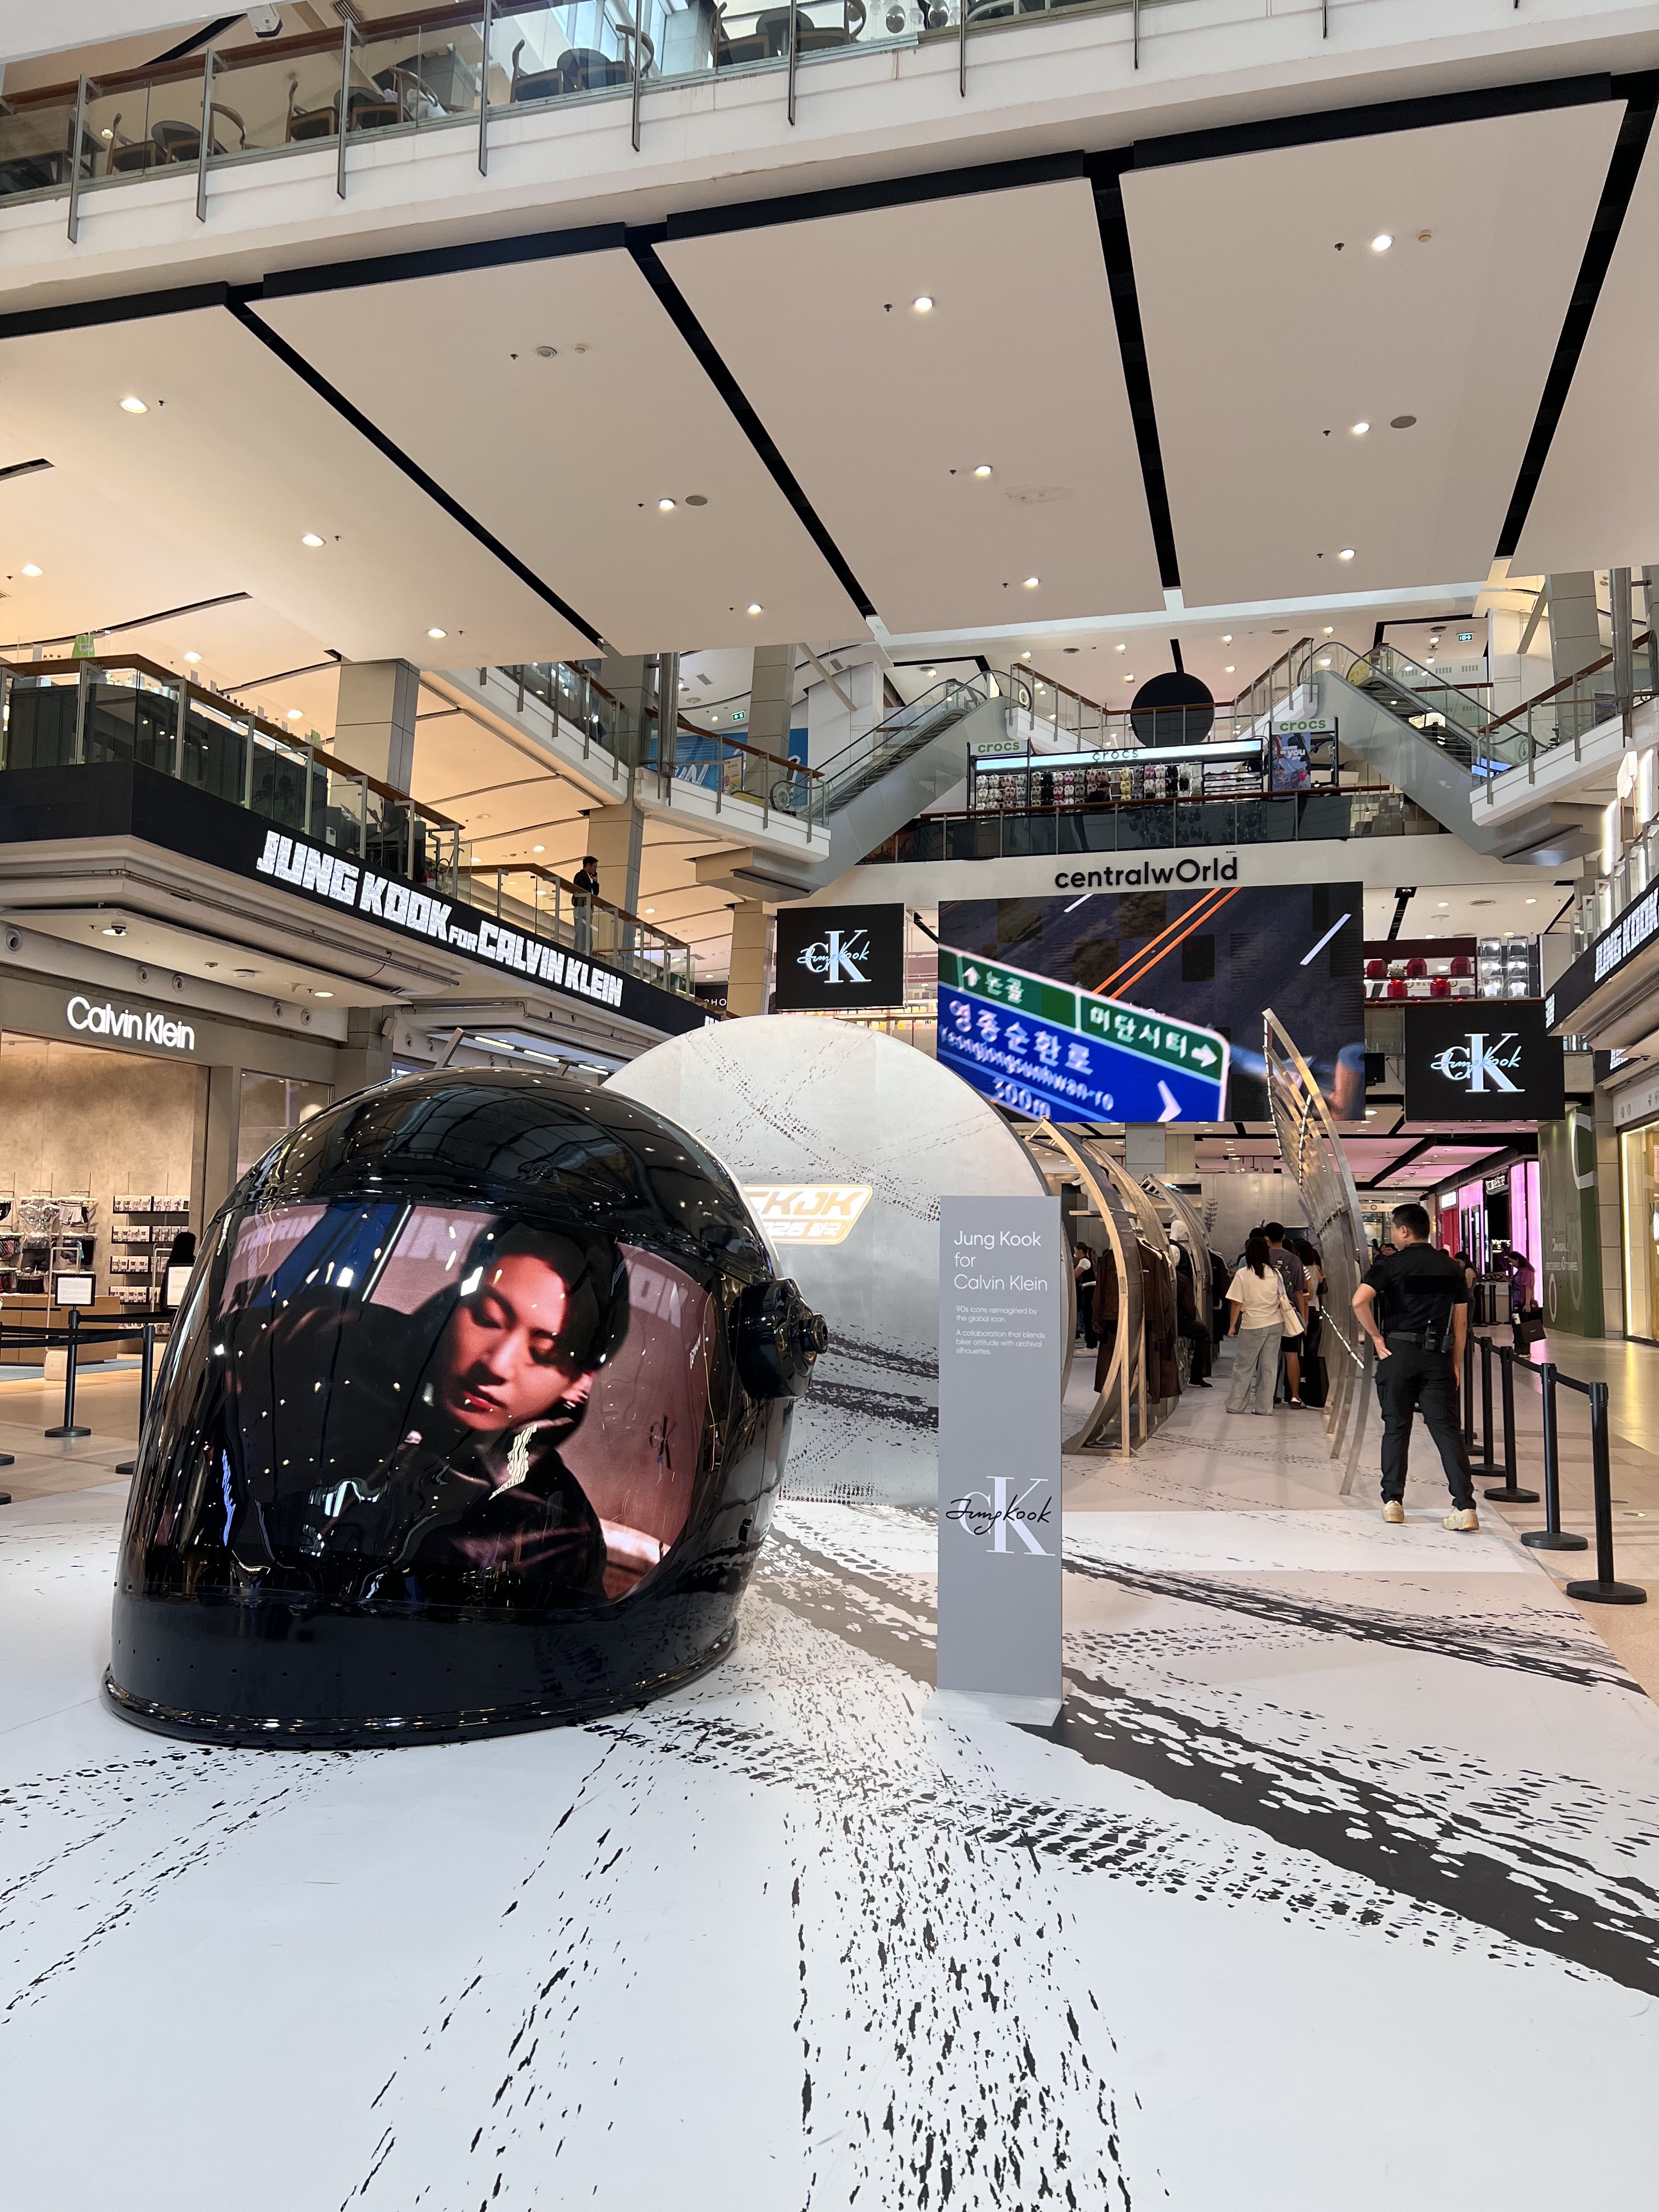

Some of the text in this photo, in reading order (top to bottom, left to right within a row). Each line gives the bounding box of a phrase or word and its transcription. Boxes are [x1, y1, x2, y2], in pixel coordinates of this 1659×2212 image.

[1279, 719, 1326, 732] crocs
[977, 741, 1020, 753] crocs
[1287, 749, 1306, 758] you
[1092, 749, 1139, 762] crocs
[256, 830, 624, 1008] JUNG KOOK FOR CALVIN KLEIN
[67, 996, 195, 1051] Calvin Klein
[1090, 1006, 1188, 1058] 미단시티
[953, 1230, 1042, 1250] Jung Kook
[953, 1251, 977, 1268] for
[953, 1273, 1048, 1291] Calvin Klein
[989, 1307, 1028, 1316] reimagined
[1028, 1307, 1038, 1316] by
[968, 1315, 990, 1323] global
[1023, 1331, 1046, 1339] blends
[956, 1347, 992, 1355] silhouettes.
[957, 1476, 1056, 1556] CK
